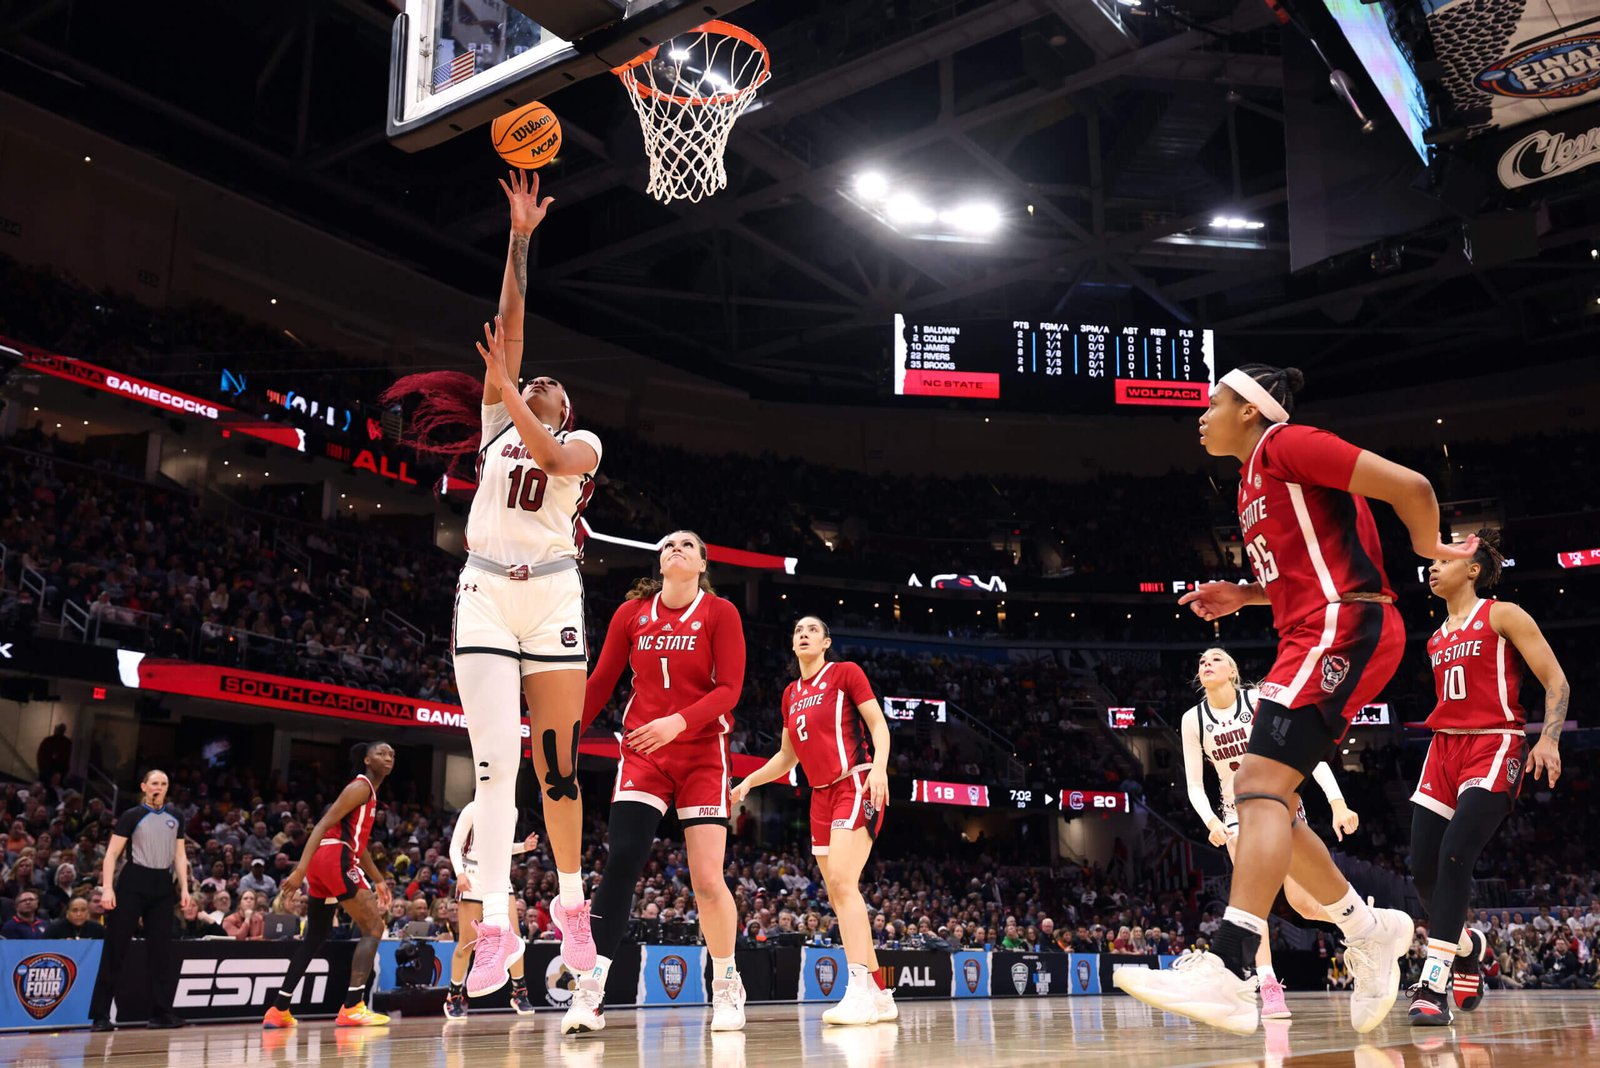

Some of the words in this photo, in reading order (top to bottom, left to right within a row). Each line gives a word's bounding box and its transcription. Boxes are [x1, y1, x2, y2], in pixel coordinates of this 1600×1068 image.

[511, 114, 552, 142] Wilson
[530, 132, 559, 158] NCAA
[913, 325, 918, 333] 1
[923, 325, 960, 335] BALDWIN
[1046, 332, 1062, 340] 1/4
[1088, 334, 1105, 342] 0/0
[1128, 336, 1134, 344] 0
[1156, 337, 1162, 345] 2
[1183, 338, 1190, 346] 0
[1013, 321, 1030, 330] PTS
[1040, 322, 1069, 332] FGM/A
[1080, 324, 1110, 334] 3PM/A
[1122, 327, 1139, 335] AST
[1150, 328, 1167, 336] REB
[1179, 329, 1194, 338] FLS
[910, 343, 922, 351] 10
[923, 344, 950, 352] JAMES
[1046, 350, 1062, 358] 3/8
[1088, 352, 1104, 360] 2/5
[1128, 353, 1134, 361] 0
[912, 334, 918, 342] 2
[923, 334, 956, 344] COLLINS
[1017, 339, 1024, 347] 2
[1046, 341, 1061, 350] 1/1
[1088, 343, 1105, 352] 0/0
[1128, 344, 1134, 352] 0
[1183, 347, 1190, 355] 0
[910, 352, 922, 360] 22
[923, 352, 950, 360] RIVERS
[1017, 356, 1024, 364] 2
[1046, 358, 1062, 367] 1/5
[1088, 360, 1104, 369] 0/1
[1184, 364, 1190, 372] 0
[923, 361, 956, 370] BROOKS
[1046, 367, 1062, 376] 2/3
[1088, 369, 1104, 378] 0/1
[944, 380, 983, 389] STATE
[1128, 388, 1199, 398] WOLFPACK
[106, 376, 219, 420] GAMECOCKS
[352, 450, 418, 485] ALL
[507, 465, 549, 512] 10
[1246, 534, 1280, 589] 35
[638, 635, 654, 650] NC
[654, 635, 698, 650] STATE
[1444, 640, 1483, 663] STATE
[659, 657, 670, 689] 1
[1443, 665, 1467, 702] 10
[224, 676, 302, 700] SOUTH
[308, 690, 412, 720] CAROLINA
[796, 693, 824, 712] STATE
[796, 714, 808, 742] 2
[1213, 727, 1248, 747] SOUTH
[934, 786, 955, 800] 18
[1009, 790, 1032, 801] 7:02
[1093, 795, 1117, 808] 20
[698, 806, 720, 816] PACK
[28, 968, 62, 981] FINAL
[172, 958, 330, 1008] ESPN
[898, 967, 936, 987] ALL
[26, 981, 61, 998] FOUR
